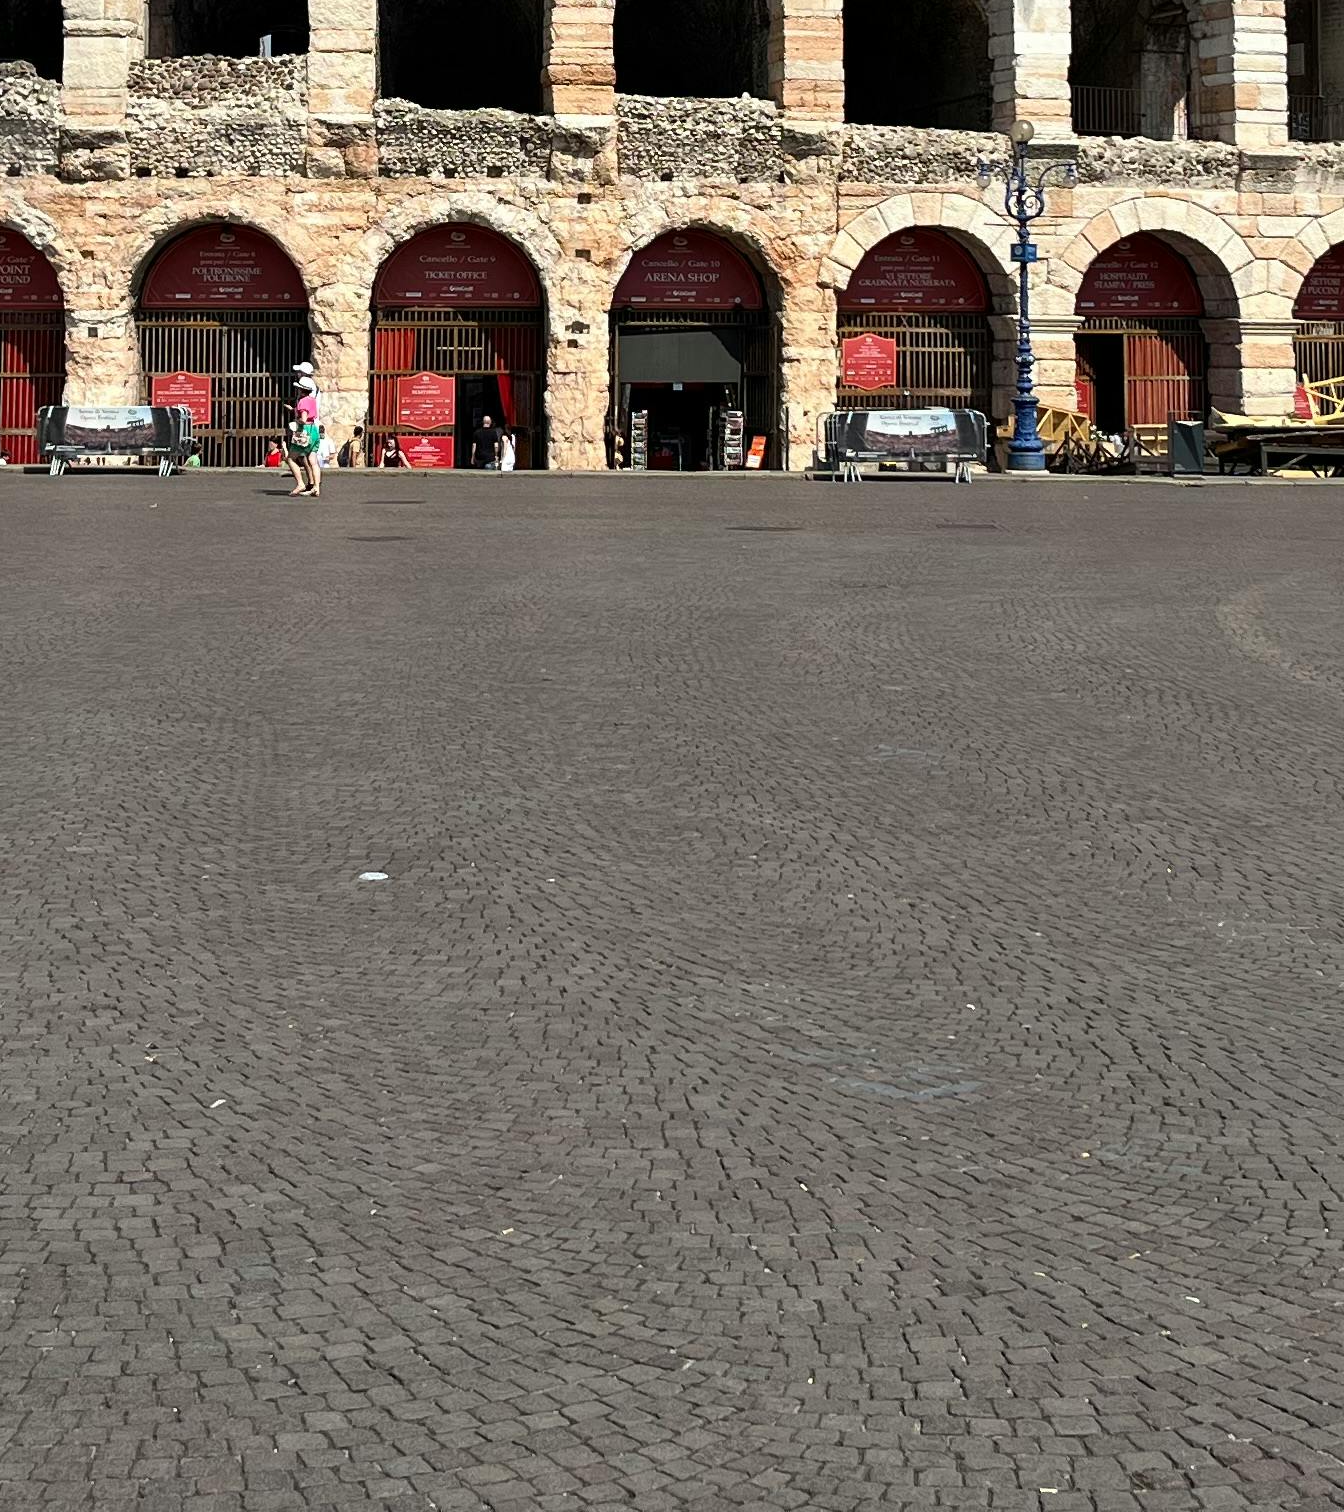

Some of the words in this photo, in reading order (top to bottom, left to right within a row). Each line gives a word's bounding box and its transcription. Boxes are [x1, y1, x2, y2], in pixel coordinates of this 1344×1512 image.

[687, 259, 708, 267] Gate
[423, 270, 455, 280] TICKET
[456, 270, 488, 280] OFFICE
[643, 272, 686, 283] ARENA
[687, 272, 720, 283] SHOP
